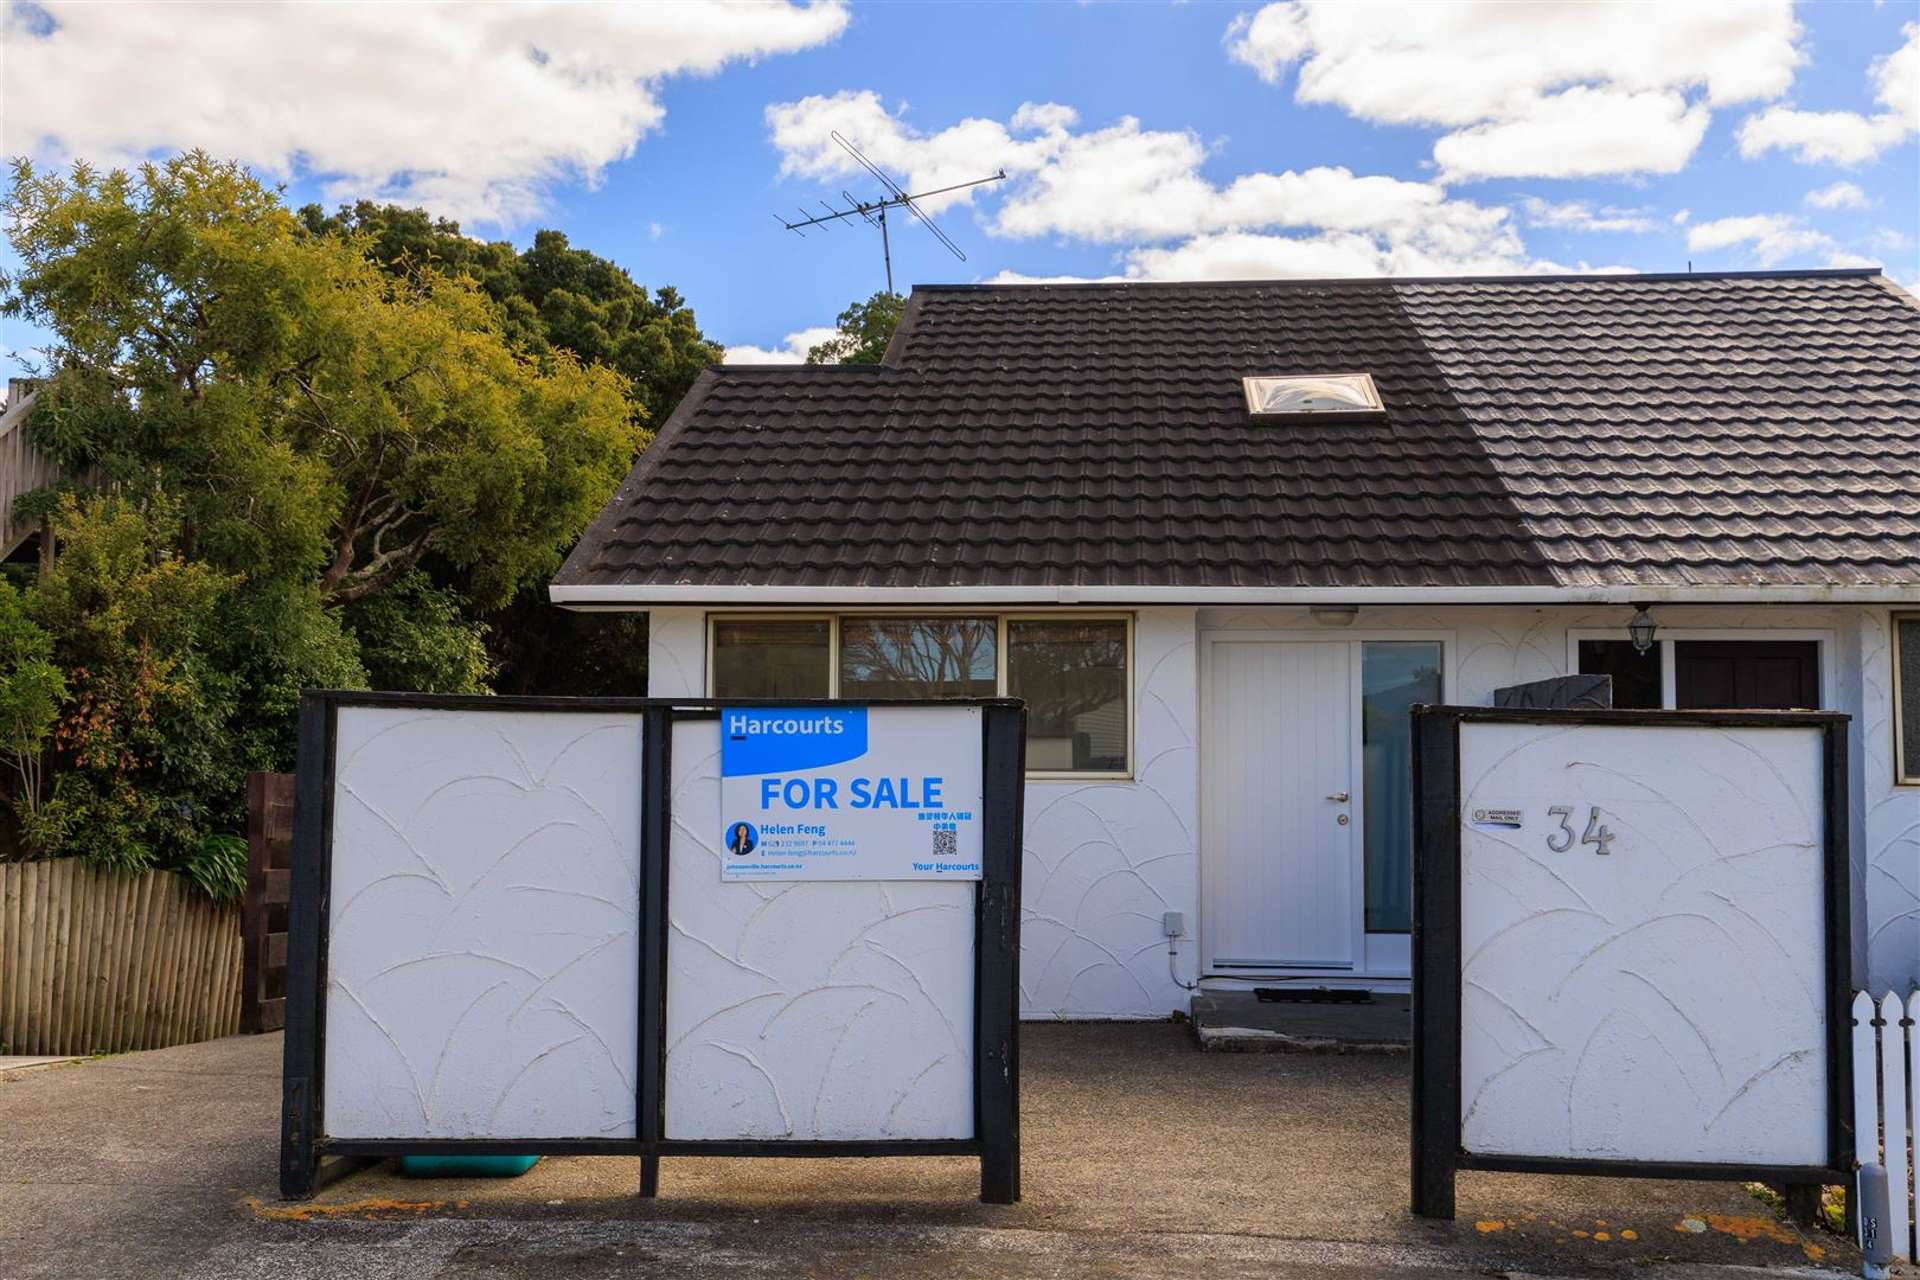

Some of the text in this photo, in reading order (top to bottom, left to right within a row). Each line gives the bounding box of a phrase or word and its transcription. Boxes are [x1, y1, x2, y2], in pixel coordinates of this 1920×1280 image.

[730, 715, 844, 735] Harcourts
[761, 777, 943, 810] FOR SALE
[760, 823, 826, 837] Helen Feng
[1547, 805, 1615, 855] 34
[912, 863, 979, 871] Your Harcourts
